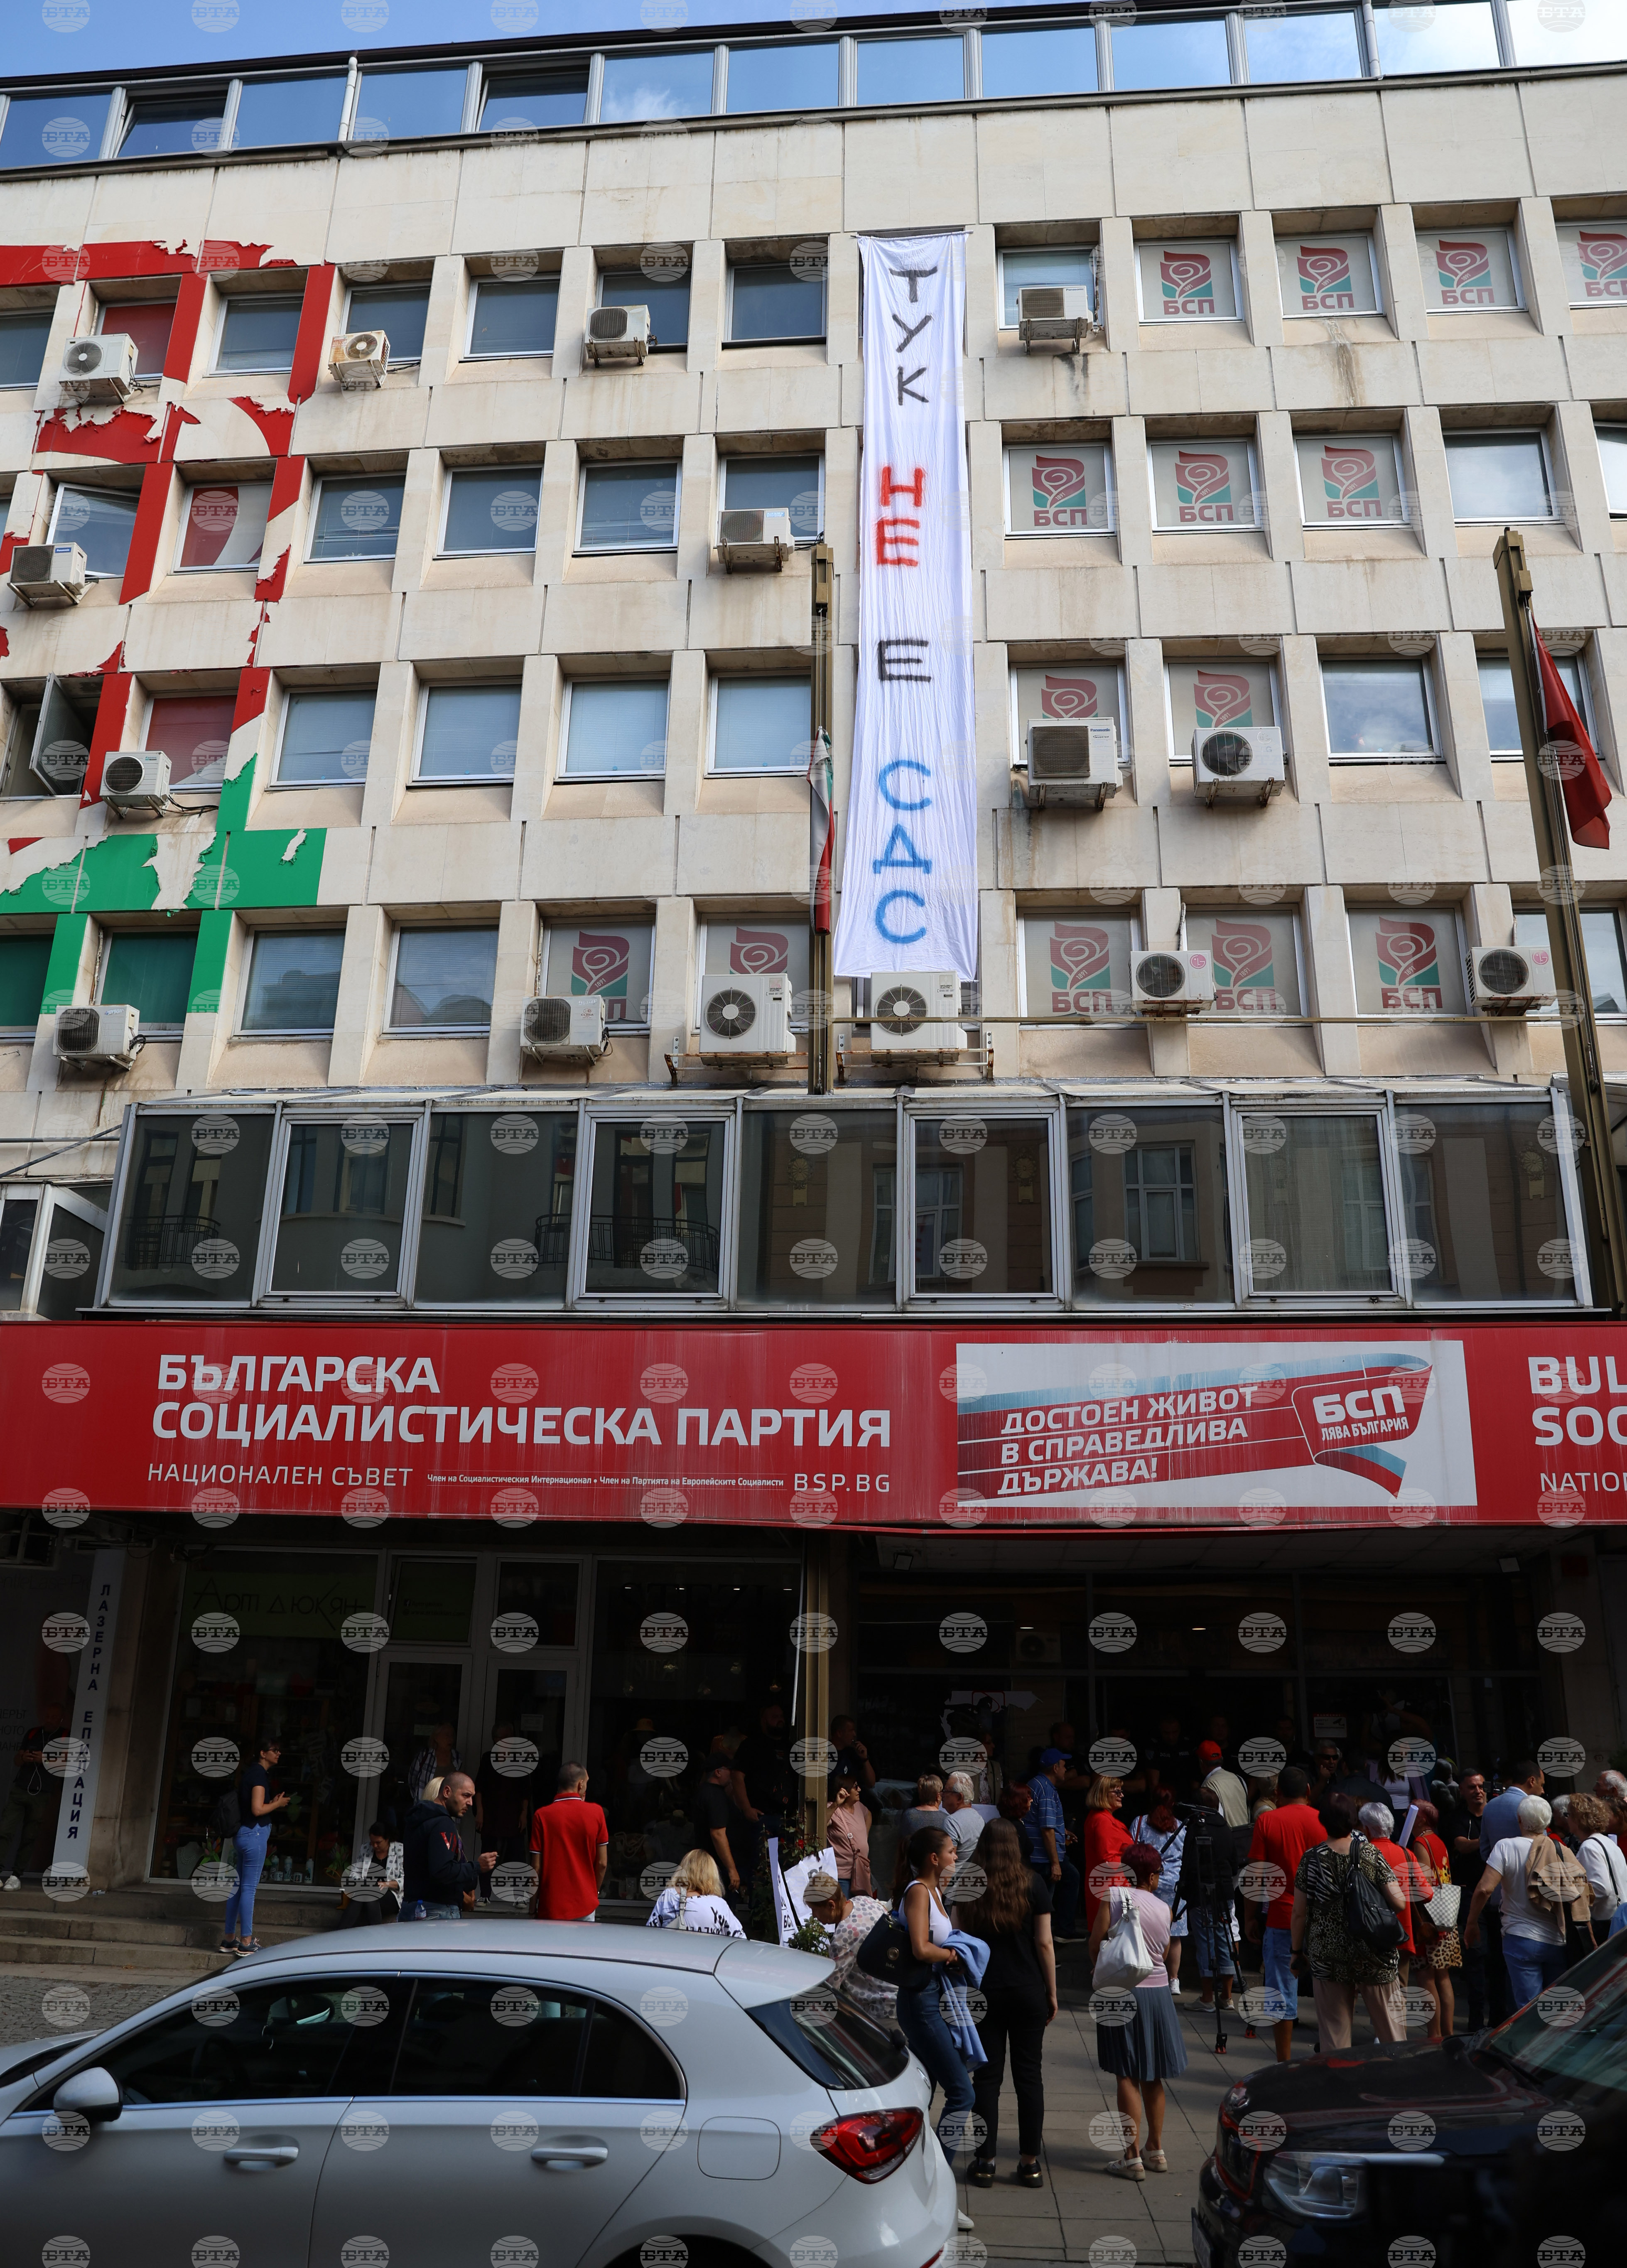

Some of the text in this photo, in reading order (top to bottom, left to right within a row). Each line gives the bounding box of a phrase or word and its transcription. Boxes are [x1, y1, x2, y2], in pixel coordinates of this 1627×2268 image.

[1183, 283, 1193, 292] 1891
[1441, 288, 1495, 304] БСП
[1163, 299, 1215, 315] БСП
[1301, 293, 1355, 310] БСП
[889, 266, 938, 406] ТУК
[1055, 492, 1066, 501] 1891
[1200, 488, 1210, 496] 1891
[1347, 482, 1358, 492] 1891
[874, 465, 926, 567] НЕ
[1034, 508, 1087, 526] БСП
[1179, 504, 1234, 522] БСП
[1327, 500, 1382, 518] БСП
[877, 638, 933, 682] Е
[1220, 712, 1231, 723] 1891
[872, 759, 933, 944] СДС
[1076, 969, 1088, 980] 1891
[1239, 967, 1250, 978] 1891
[1404, 965, 1416, 977] 1891
[594, 977, 606, 988] 1891
[1052, 991, 1112, 1013] БСП
[1215, 989, 1276, 1010] БСП
[1381, 987, 1443, 1009] БСП
[157, 1355, 440, 1393] БЪЛГАРСКА
[1001, 1386, 1258, 1435] ДОСТОЕН ЖИВОТ
[1313, 1386, 1406, 1424] БСП
[152, 1402, 891, 1447] СОЦИАЛИСТИЧЕСКА ПАРТИЯ
[1321, 1416, 1409, 1441] ЛЯВА БЪЛГАРИЯ
[1001, 1418, 1248, 1464] В СПРАВЕДЛИВА
[148, 1463, 413, 1487] НАЦИОНАЛЕН СЪВЕТ
[427, 1474, 446, 1482] Член
[459, 1474, 529, 1484] Социалистическия
[531, 1475, 591, 1485] Интернационал
[632, 1477, 668, 1486] Партията
[682, 1477, 736, 1487] Европейските
[738, 1478, 784, 1487] Социалисти
[794, 1473, 890, 1492] BSP.BG
[997, 1457, 1158, 1495] ДЪРЖАВА!
[88, 1584, 110, 1691] ЛАЗЕРНА
